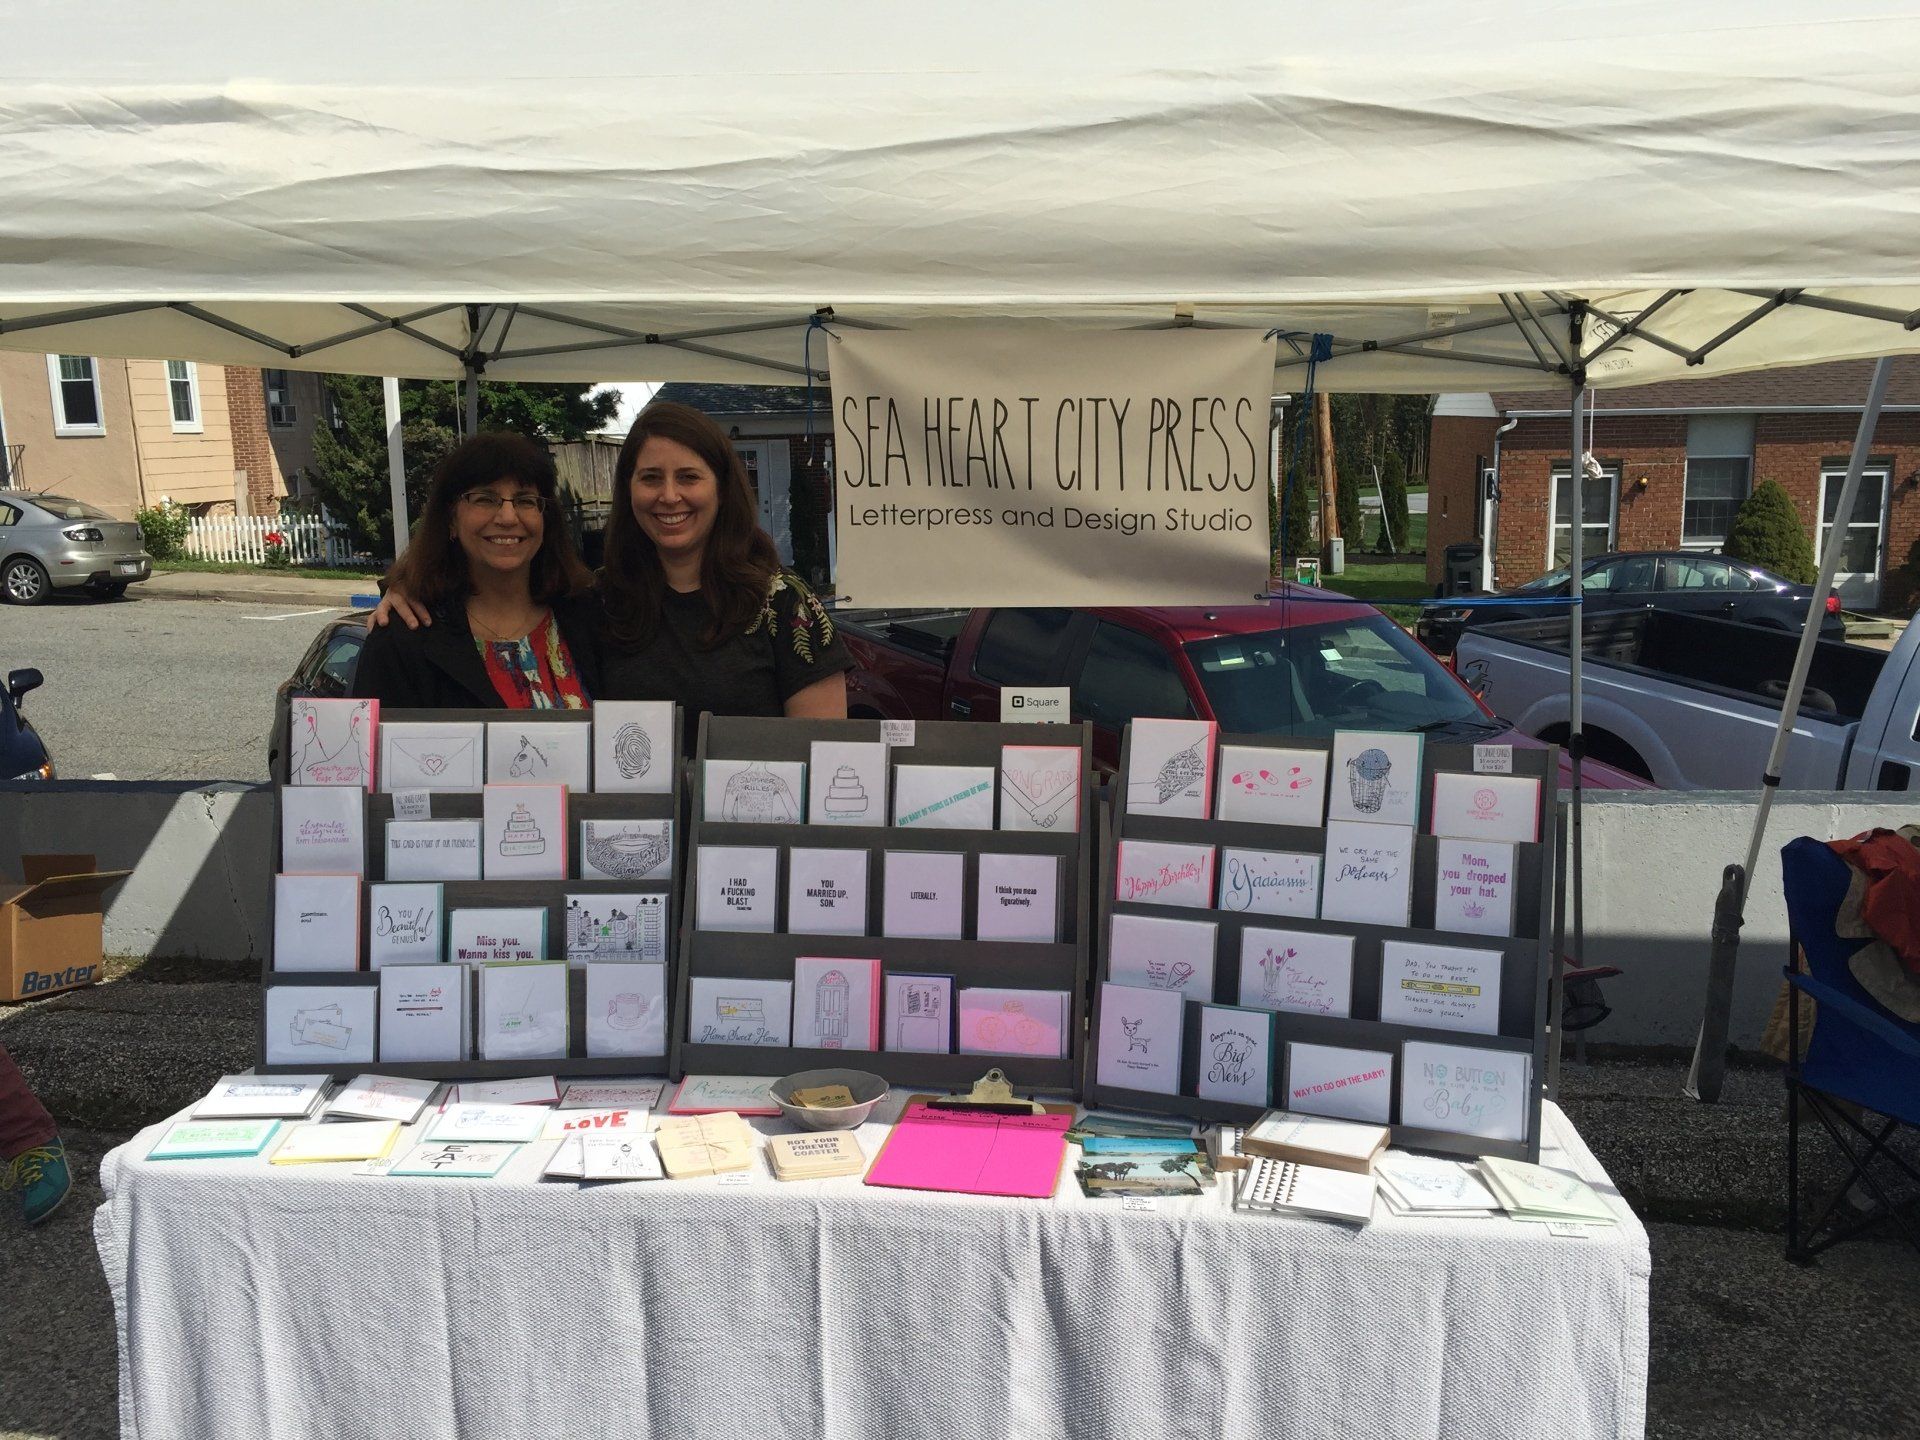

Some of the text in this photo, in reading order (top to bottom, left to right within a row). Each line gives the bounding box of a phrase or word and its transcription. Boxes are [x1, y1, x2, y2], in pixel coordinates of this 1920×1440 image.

[842, 396, 1257, 493] SEA HEART CITY PRESS
[849, 504, 1253, 536] Letterpress and Design Studio
[1026, 697, 1060, 709] Square
[953, 790, 971, 802] FRIEND
[1338, 846, 1348, 854] WE
[1354, 848, 1368, 856] CRY
[1360, 856, 1380, 864] SAME
[1462, 854, 1490, 868] Mom,
[730, 878, 748, 886] I HAD
[1442, 868, 1506, 884] you dropped
[821, 880, 834, 888] YOU
[1125, 876, 1158, 900] Happy
[720, 888, 756, 896] A FUCKING
[806, 888, 836, 898] MARRIED
[910, 892, 938, 900] LITERALLY.
[999, 886, 1012, 895] think
[1012, 887, 1022, 896] you
[1450, 884, 1498, 898] your hat.
[726, 898, 748, 906] BLAST
[820, 899, 836, 908] SON.
[1000, 896, 1032, 908] figuratively.
[398, 910, 413, 919] YOU
[376, 906, 434, 942] Beautiful
[391, 935, 414, 944] GENIUS
[476, 935, 521, 948] Miss you.
[458, 948, 534, 960] Wanna kiss you.
[1424, 961, 1436, 969] YOU
[21, 964, 97, 995] Baxter
[1405, 996, 1428, 1004] THANKS
[1440, 1010, 1464, 1018] YOURS.
[727, 1026, 752, 1042] Sweet
[1210, 1028, 1237, 1043] Congrats
[824, 1040, 840, 1048] HOME
[1213, 1042, 1253, 1074] Big
[1208, 1062, 1256, 1086] News
[1424, 1062, 1506, 1086] NO BUTTON
[1293, 1068, 1386, 1099] WAY TO GO ON THE BABY!
[1424, 1088, 1506, 1125] Baby
[563, 1111, 629, 1130] LOVE
[792, 1142, 838, 1151] FOREVER
[794, 1148, 840, 1157] COASTER
